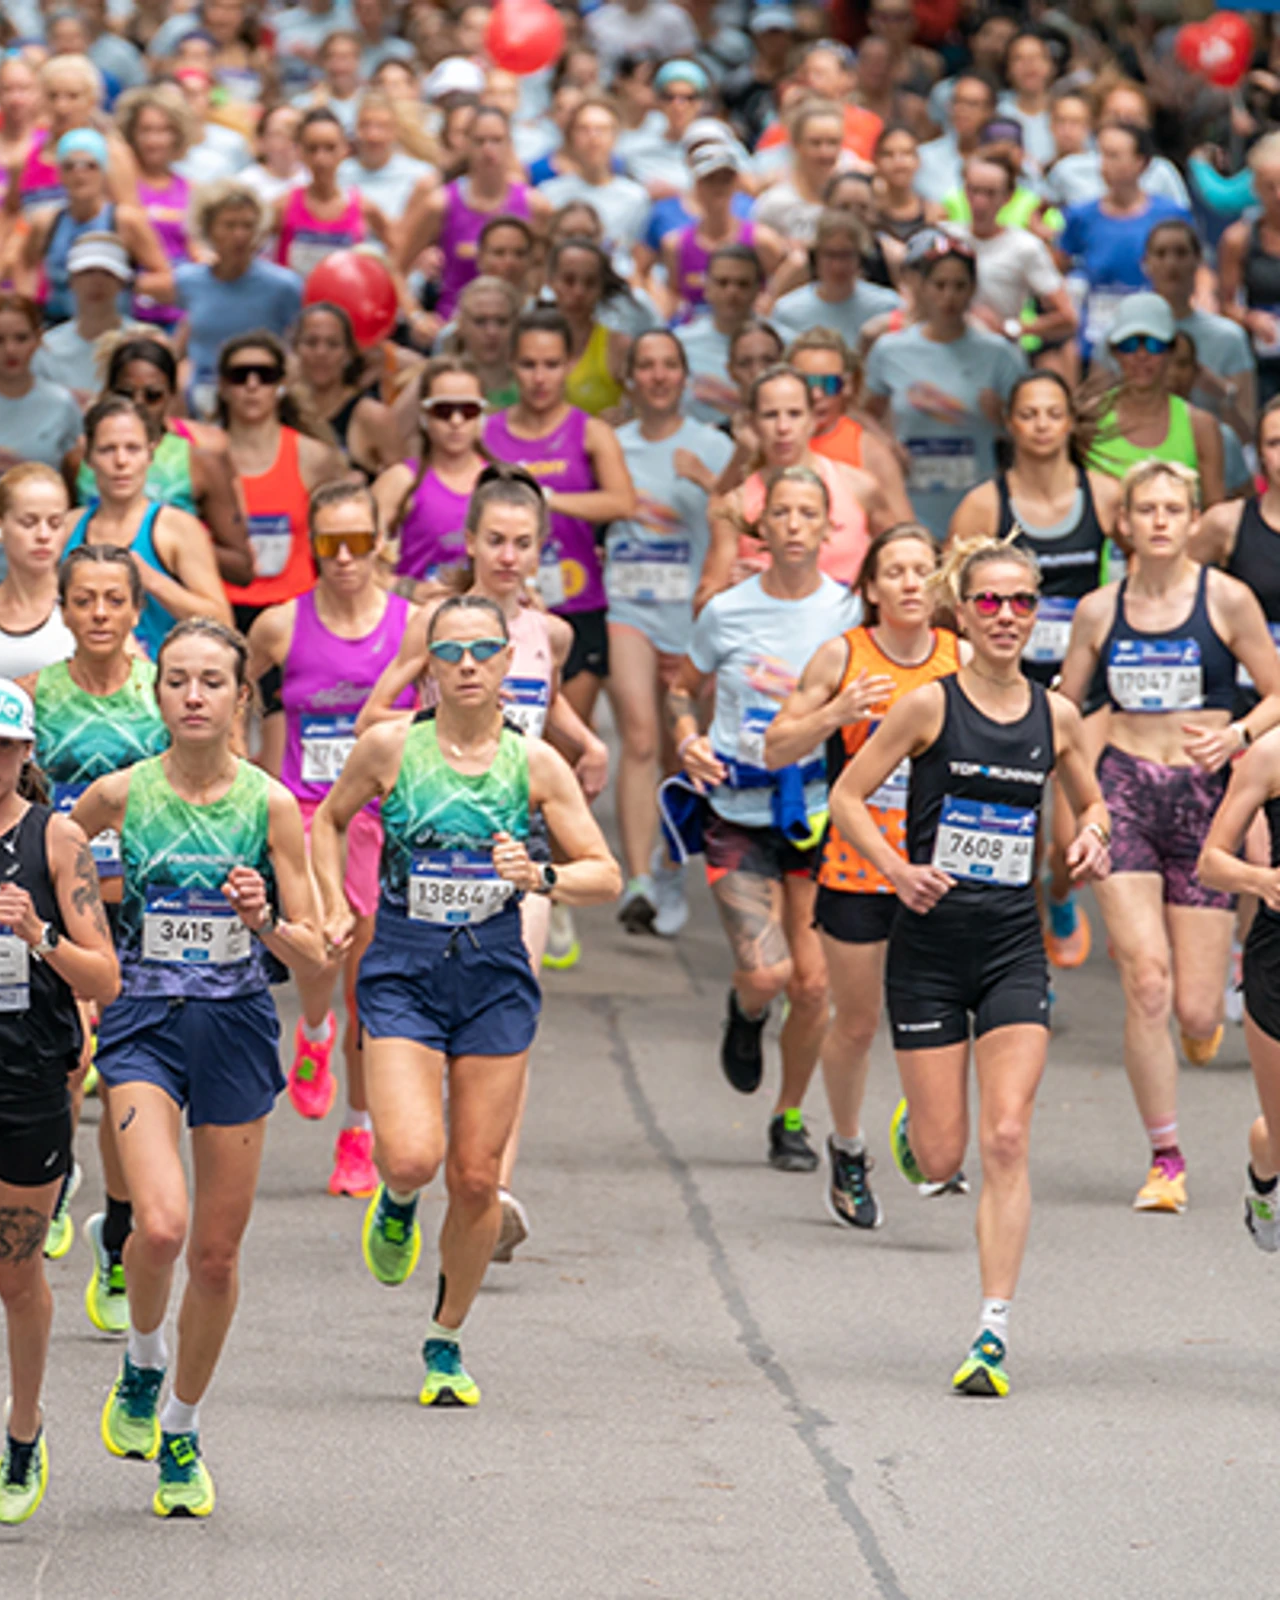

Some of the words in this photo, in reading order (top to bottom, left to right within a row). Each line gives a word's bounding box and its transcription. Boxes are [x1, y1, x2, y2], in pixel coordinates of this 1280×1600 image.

[950, 832, 1004, 860] 7608
[419, 883, 485, 905] 13864
[160, 919, 213, 942] 3415
